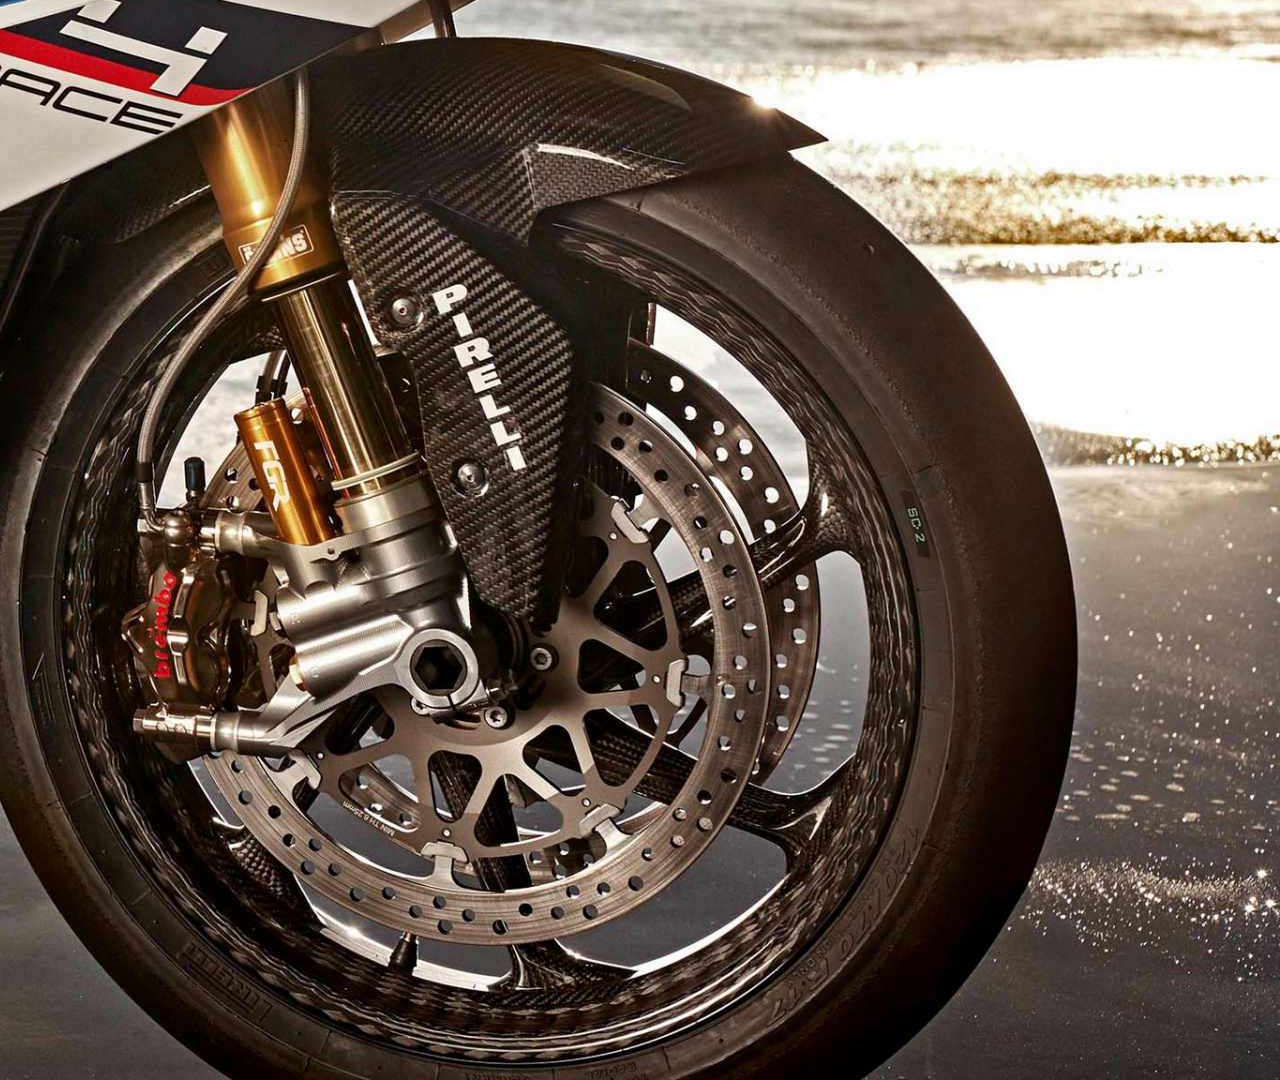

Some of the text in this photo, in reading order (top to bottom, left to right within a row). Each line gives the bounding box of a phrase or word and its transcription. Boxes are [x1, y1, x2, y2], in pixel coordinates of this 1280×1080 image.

[432, 283, 526, 471] PIRELLI
[253, 440, 290, 512] FGR
[153, 572, 177, 678] brembo
[380, 825, 396, 836] MIN
